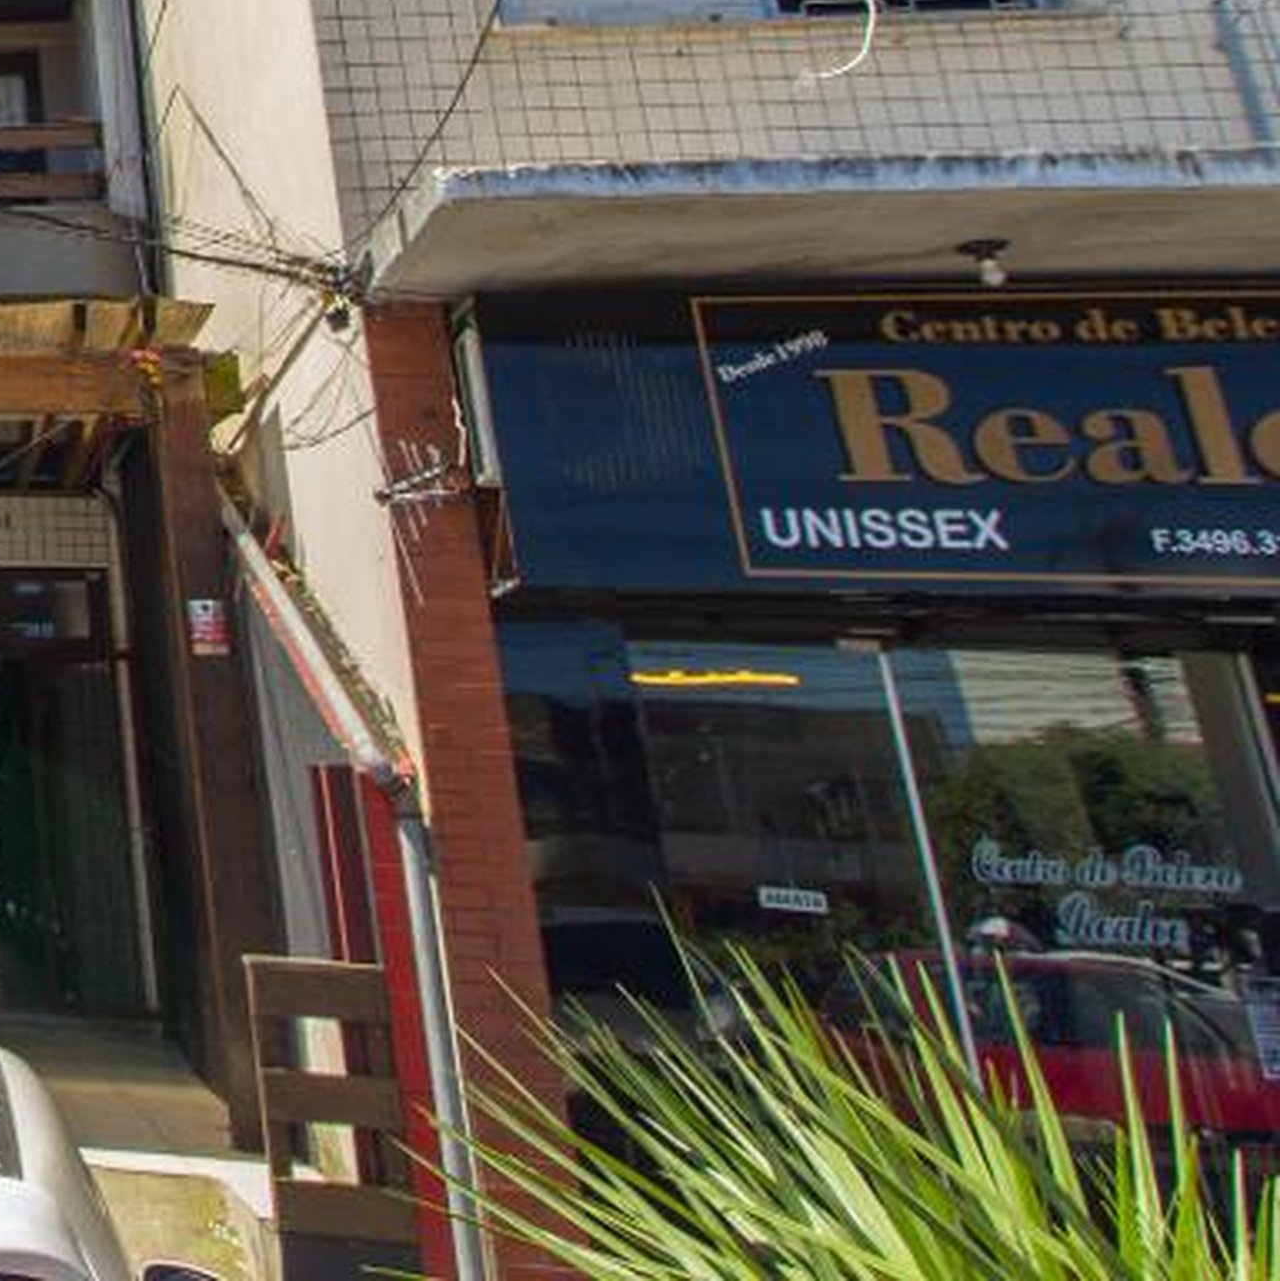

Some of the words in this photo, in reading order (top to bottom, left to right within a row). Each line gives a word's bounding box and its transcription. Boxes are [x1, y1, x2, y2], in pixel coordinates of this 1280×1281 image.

[881, 307, 1063, 344] Centro
[1073, 307, 1140, 343] de
[760, 508, 1010, 550] UNISSEX
[1149, 528, 1280, 555] F.3496.3
